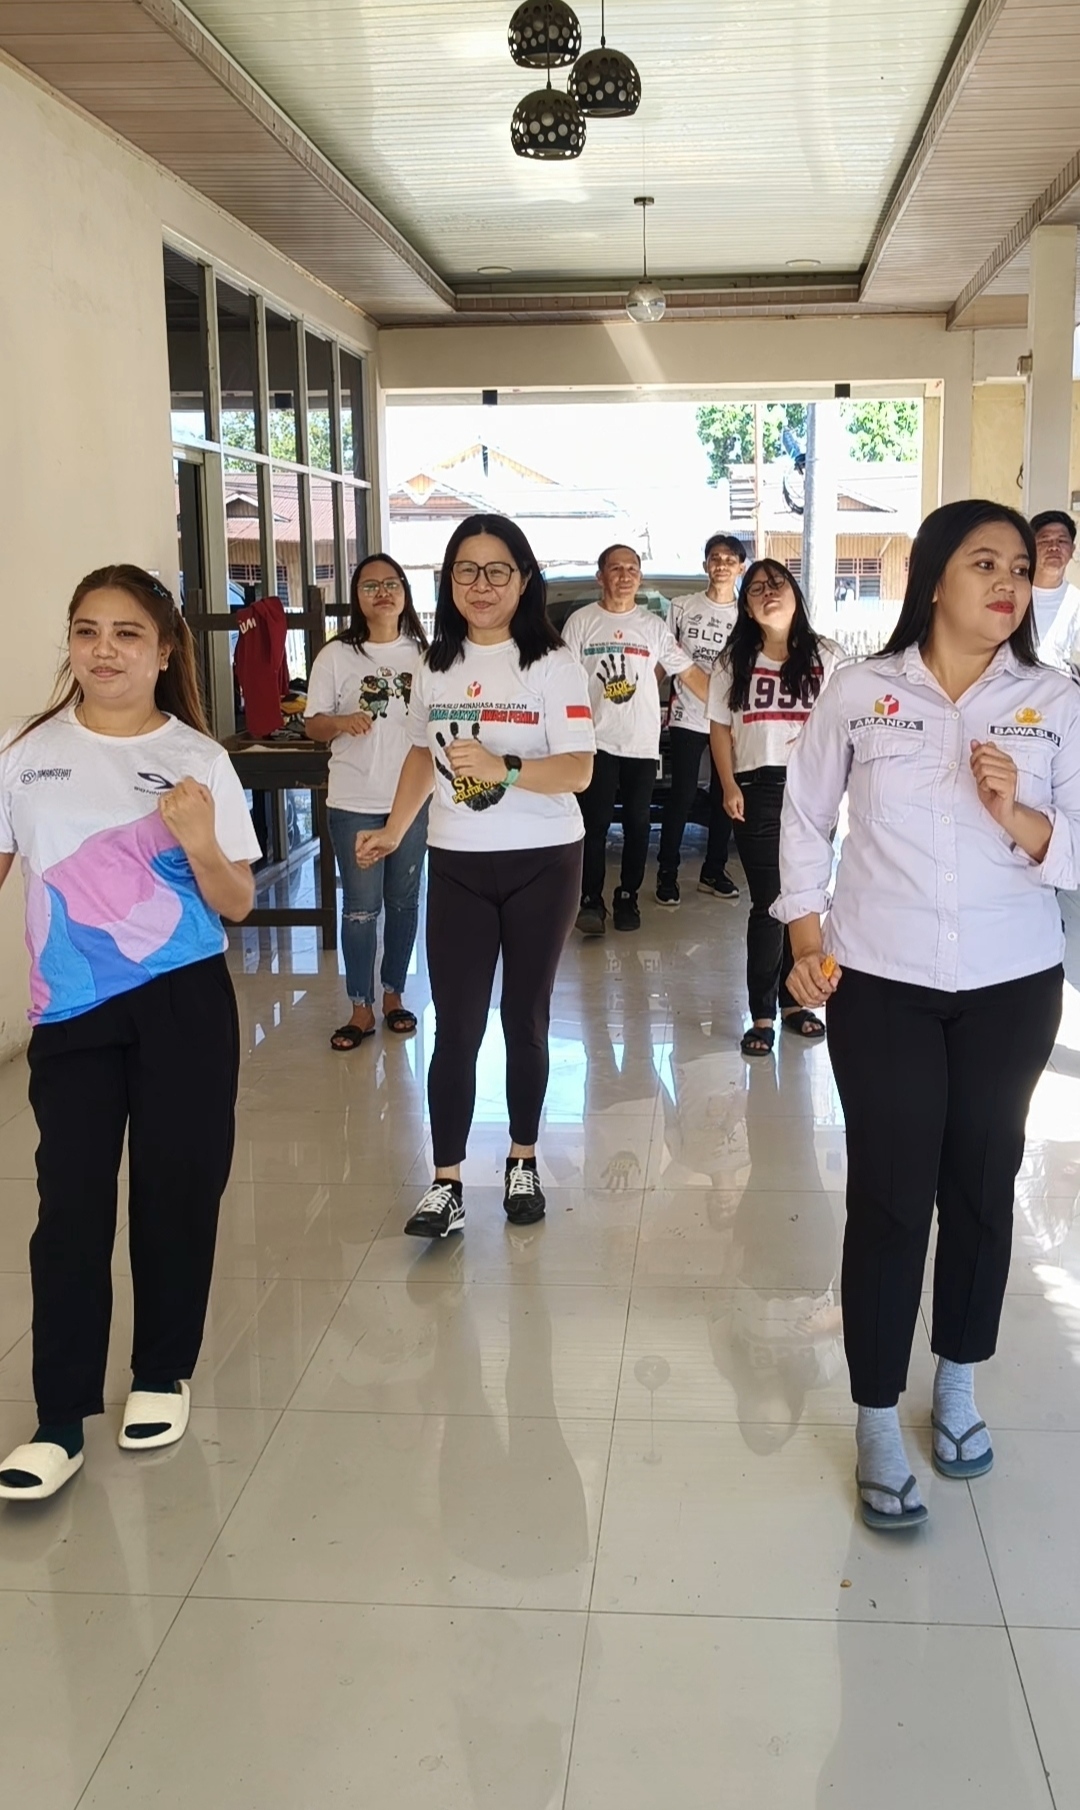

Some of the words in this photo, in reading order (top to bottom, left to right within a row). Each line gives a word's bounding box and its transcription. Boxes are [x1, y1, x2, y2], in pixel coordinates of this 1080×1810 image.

[606, 680, 629, 693] STOP
[449, 709, 480, 722] RAKYAT
[480, 709, 508, 723] AWASI
[508, 710, 540, 725] PEMILU
[855, 717, 917, 731] AMANDA
[994, 726, 1058, 742] BAWASLU
[453, 785, 484, 803] POLITIK
